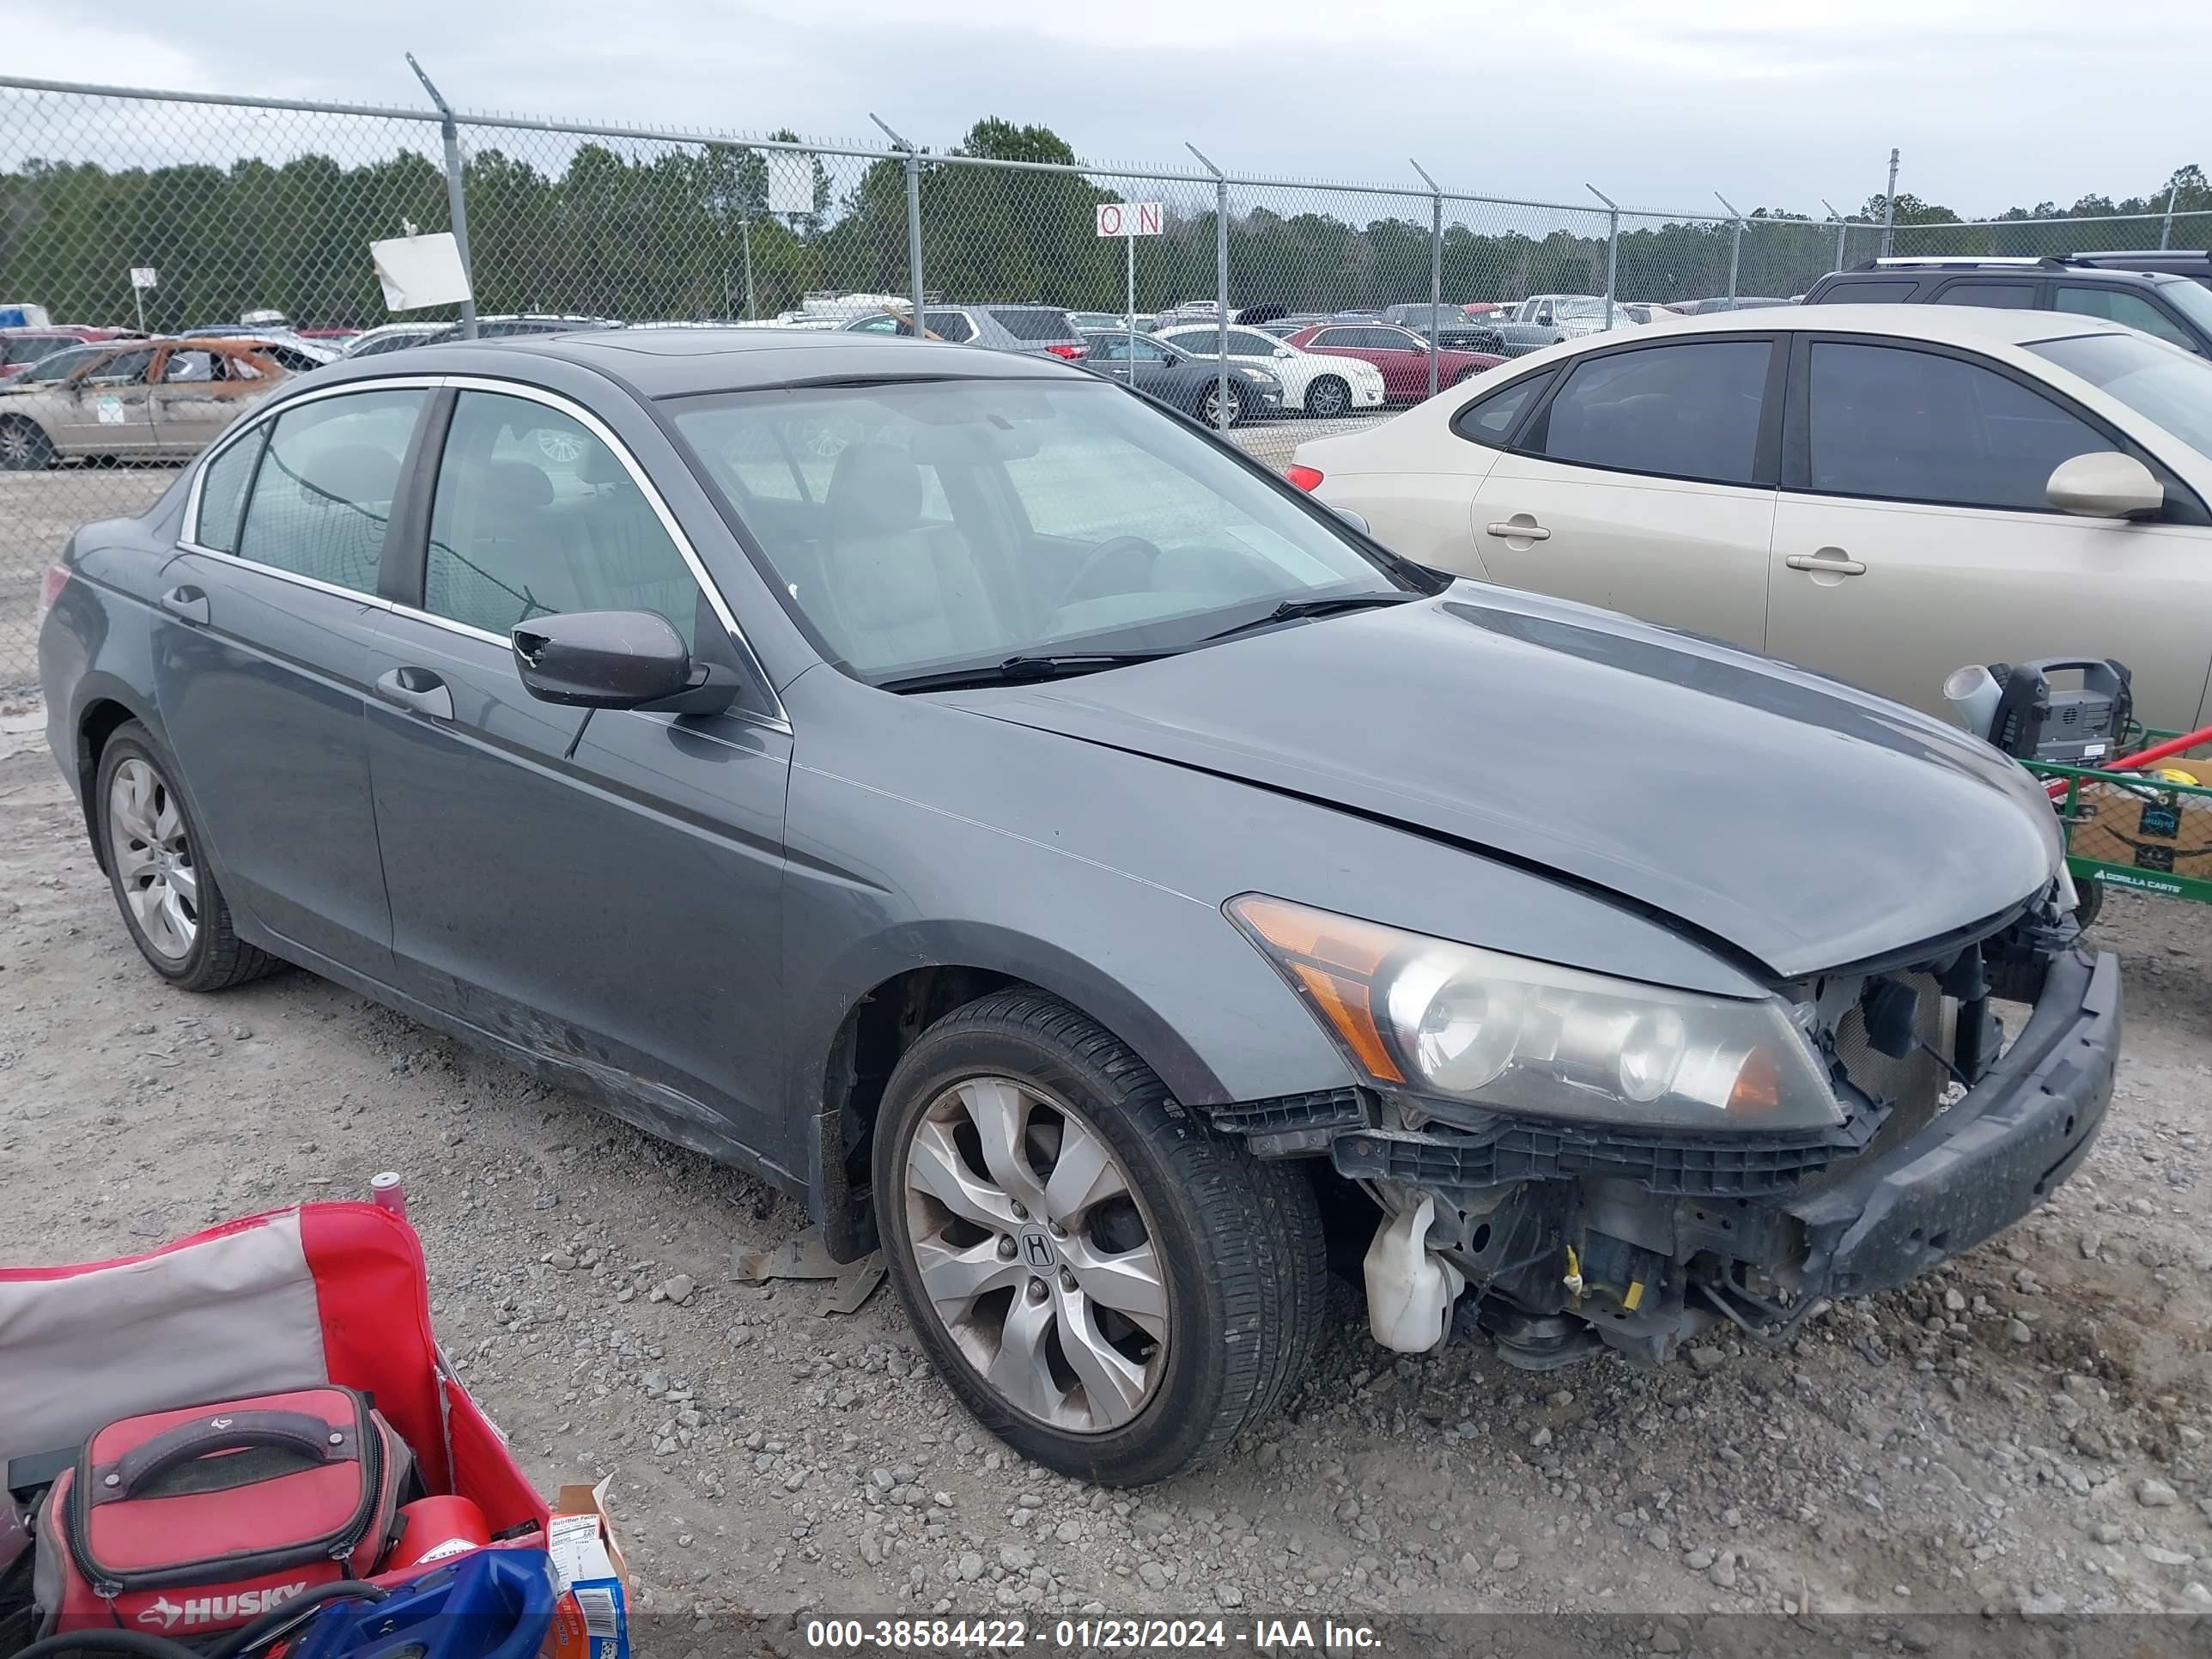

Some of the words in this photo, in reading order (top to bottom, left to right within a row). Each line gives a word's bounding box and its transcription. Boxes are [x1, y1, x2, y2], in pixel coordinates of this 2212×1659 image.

[2106, 872, 2146, 886] GORILLA
[552, 1516, 580, 1526] Nutrition
[184, 1582, 307, 1626] HUSKY
